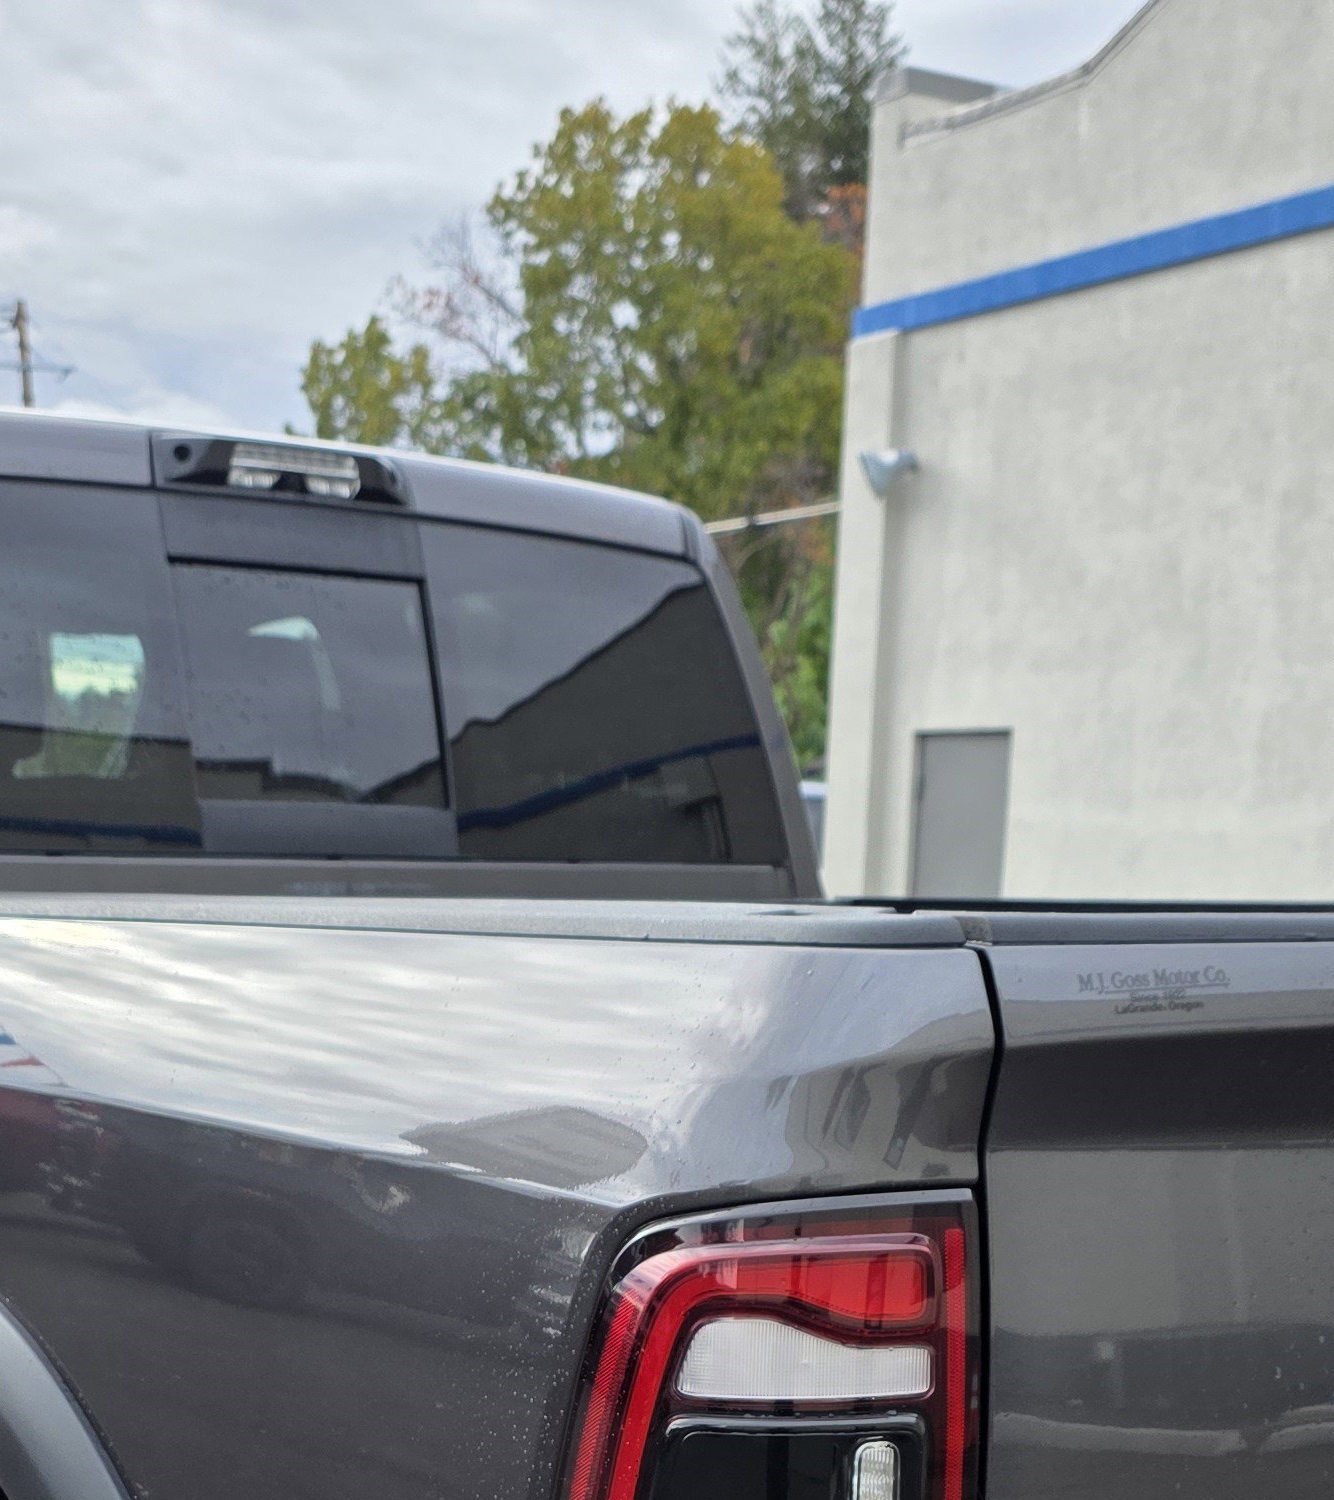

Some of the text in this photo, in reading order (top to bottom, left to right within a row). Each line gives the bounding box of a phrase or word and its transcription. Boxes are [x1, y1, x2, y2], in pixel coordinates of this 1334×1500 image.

[1077, 965, 1232, 995] M.J. Goss Motor Co.
